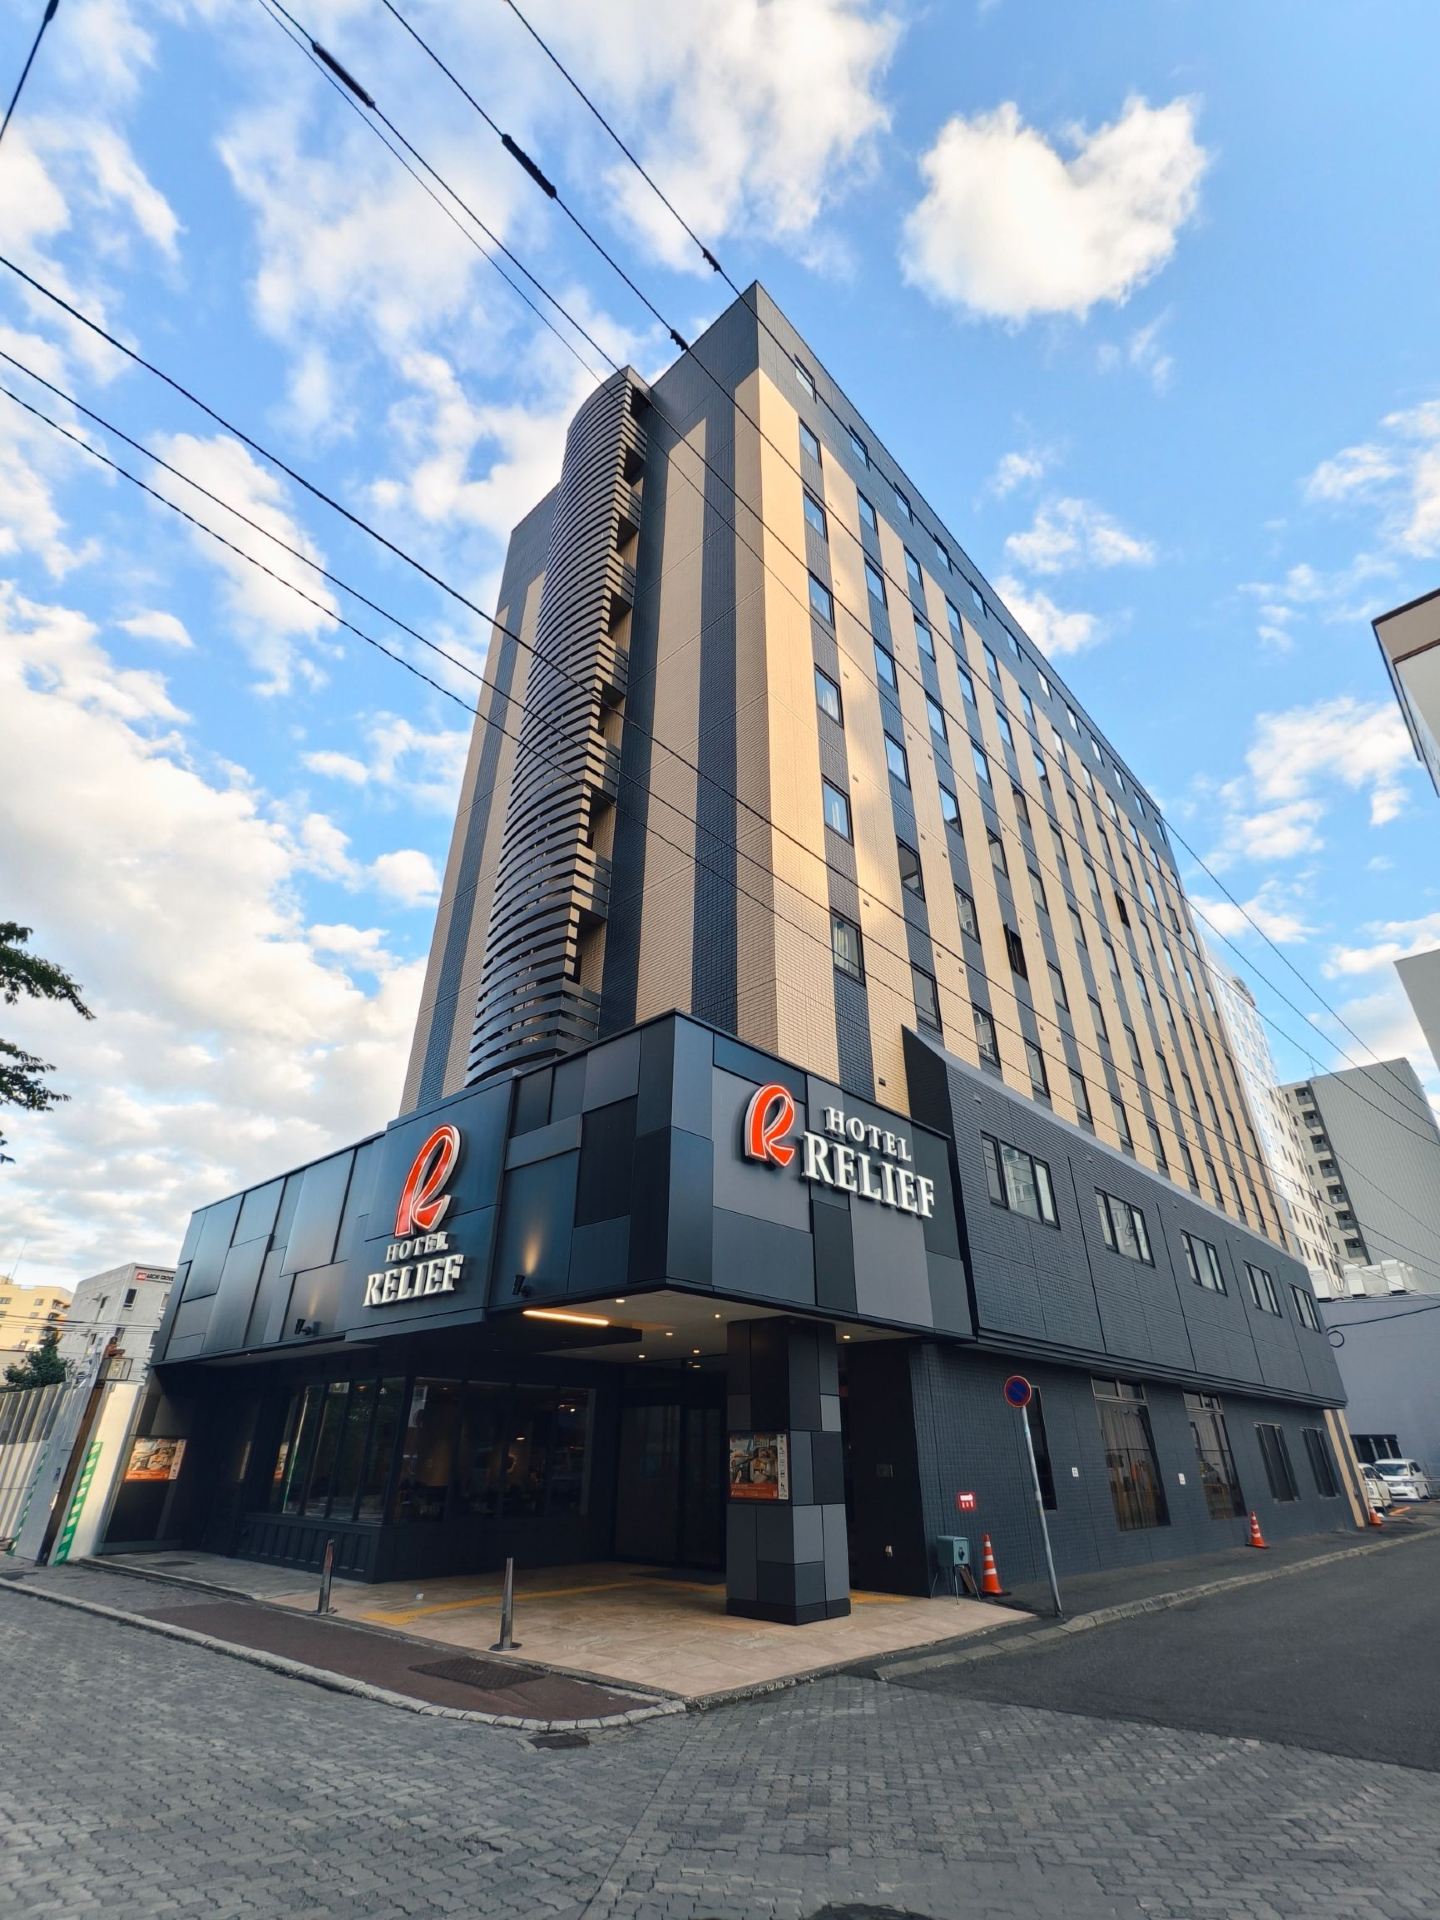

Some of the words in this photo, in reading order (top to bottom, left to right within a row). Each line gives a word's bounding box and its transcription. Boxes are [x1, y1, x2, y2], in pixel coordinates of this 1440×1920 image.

[823, 1106, 912, 1162] HOTEL
[801, 1131, 935, 1219] RELIEF
[385, 1232, 449, 1263] HOTEL
[362, 1254, 464, 1307] RELIEF
